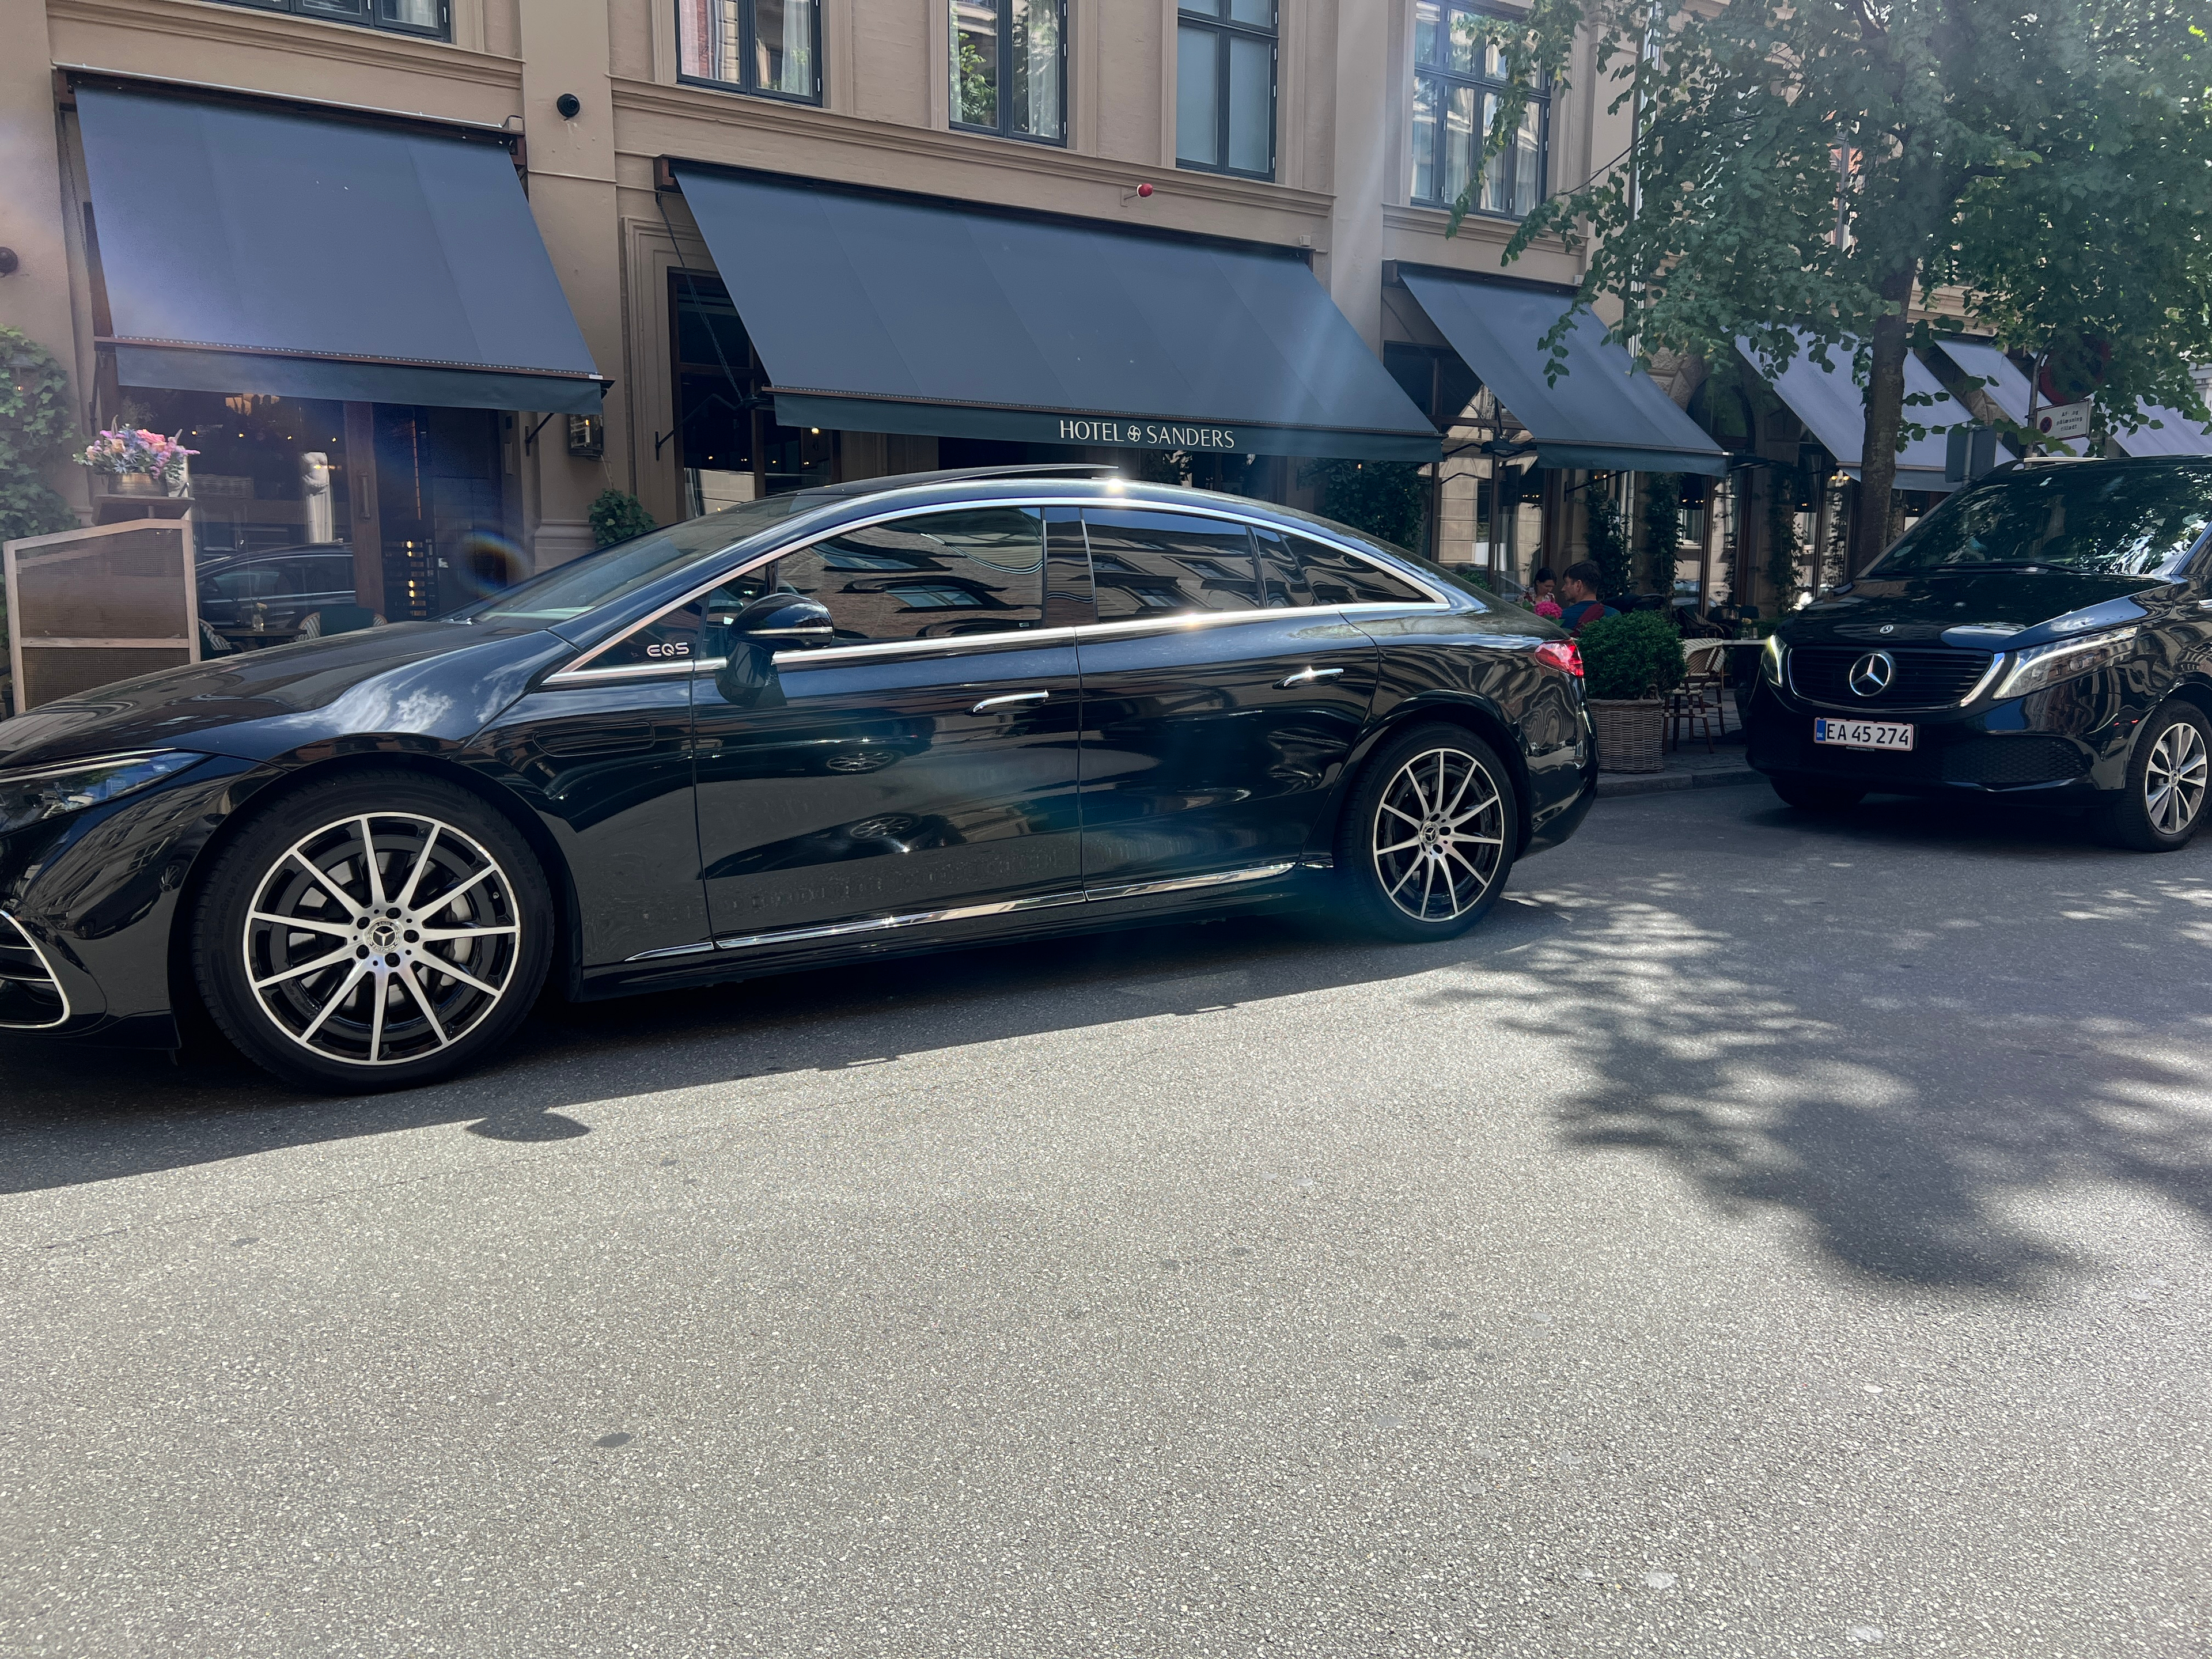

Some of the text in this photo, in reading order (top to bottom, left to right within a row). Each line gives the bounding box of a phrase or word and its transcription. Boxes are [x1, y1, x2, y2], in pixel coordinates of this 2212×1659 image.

[1059, 419, 1234, 449] HOTEL SANDERS
[646, 642, 690, 657] EQS
[1826, 724, 1909, 745] EA 45 274
